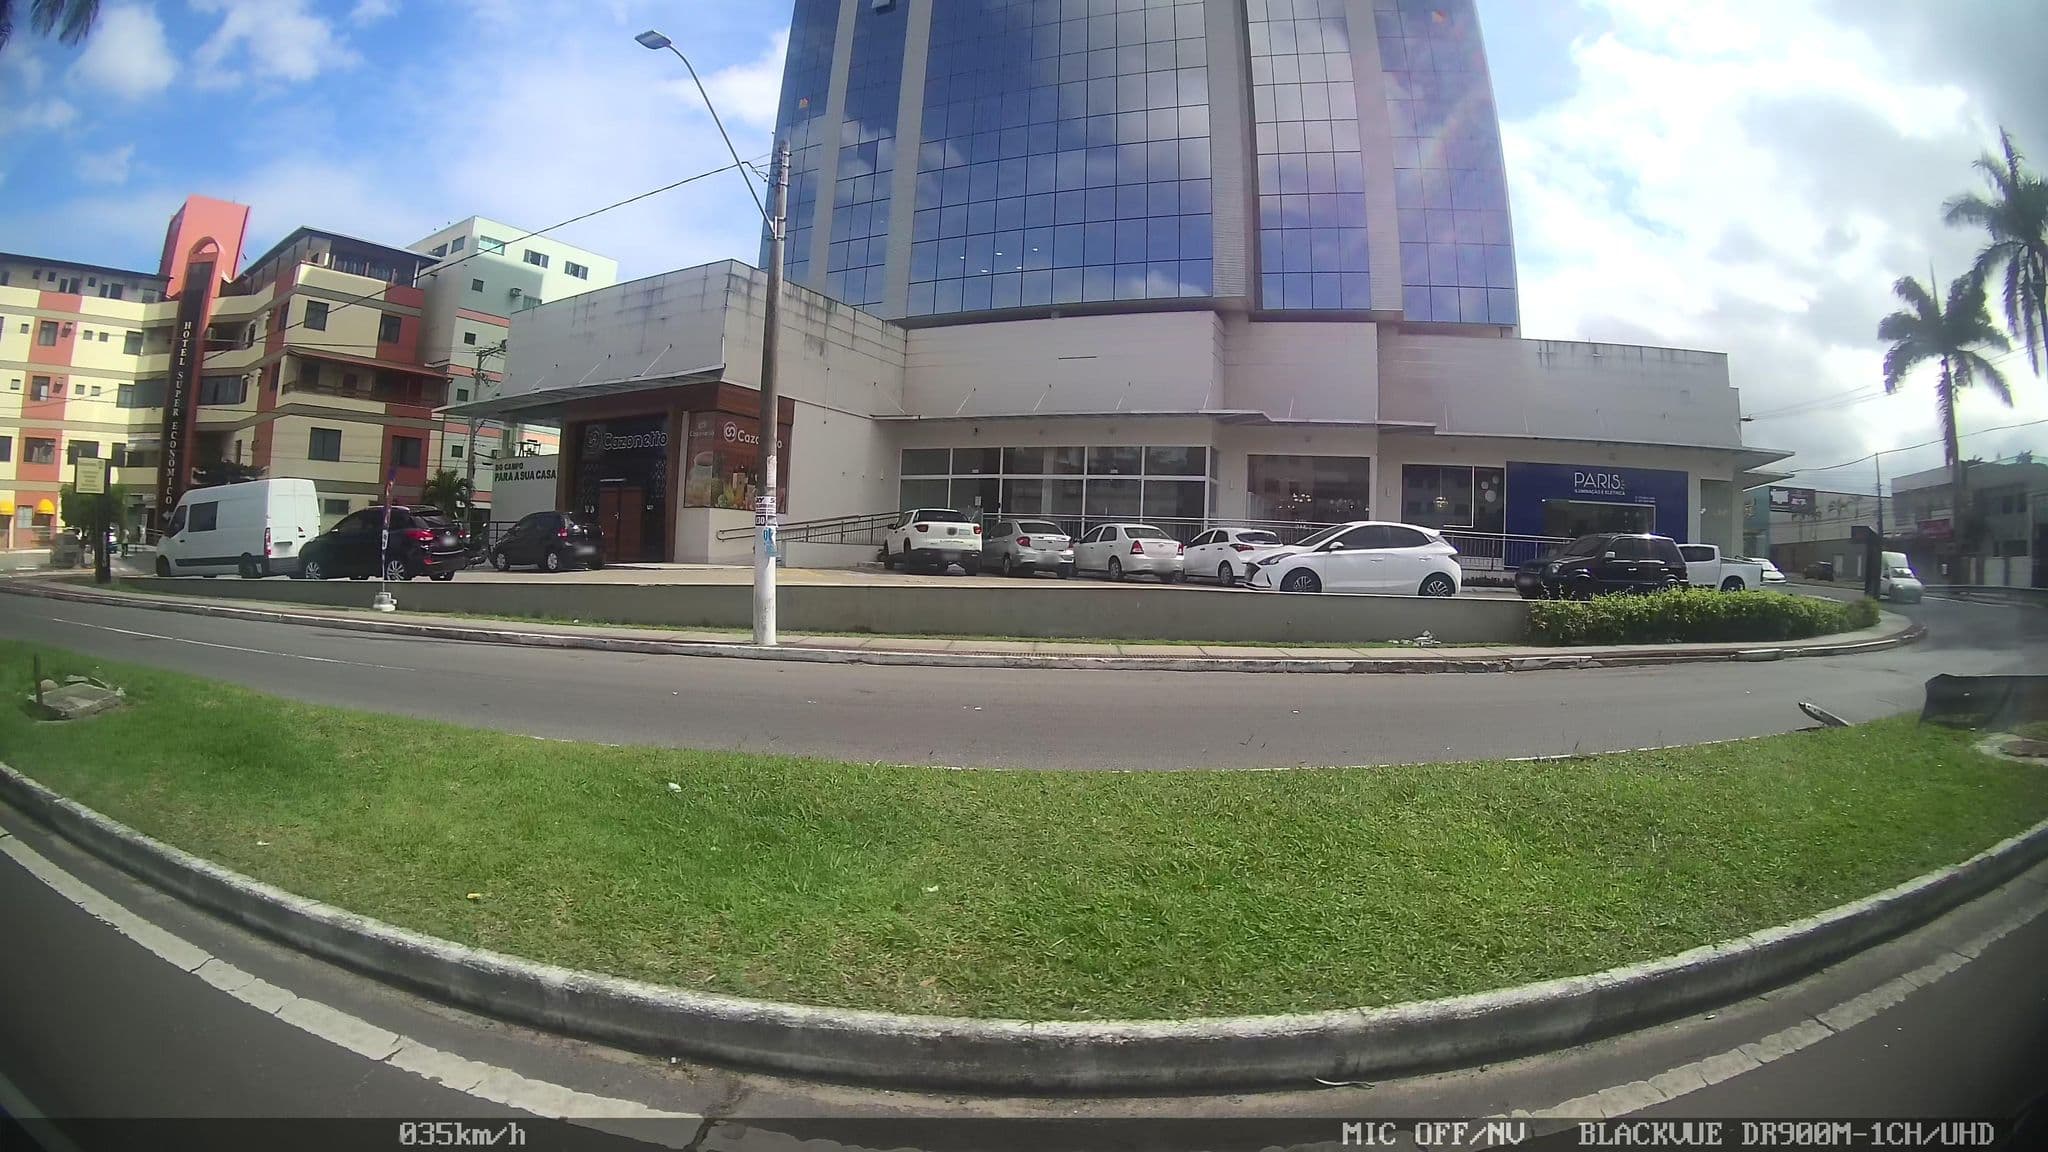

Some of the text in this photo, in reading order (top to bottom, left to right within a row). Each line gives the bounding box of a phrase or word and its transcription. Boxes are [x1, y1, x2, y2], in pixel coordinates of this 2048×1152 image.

[179, 321, 192, 366] HOTEL
[172, 371, 184, 417] SUPER
[603, 431, 669, 450] Cazonetto
[494, 471, 513, 482] PARA
[519, 470, 535, 480] SUA
[535, 469, 557, 480] CASA
[1574, 472, 1620, 489] PARIS
